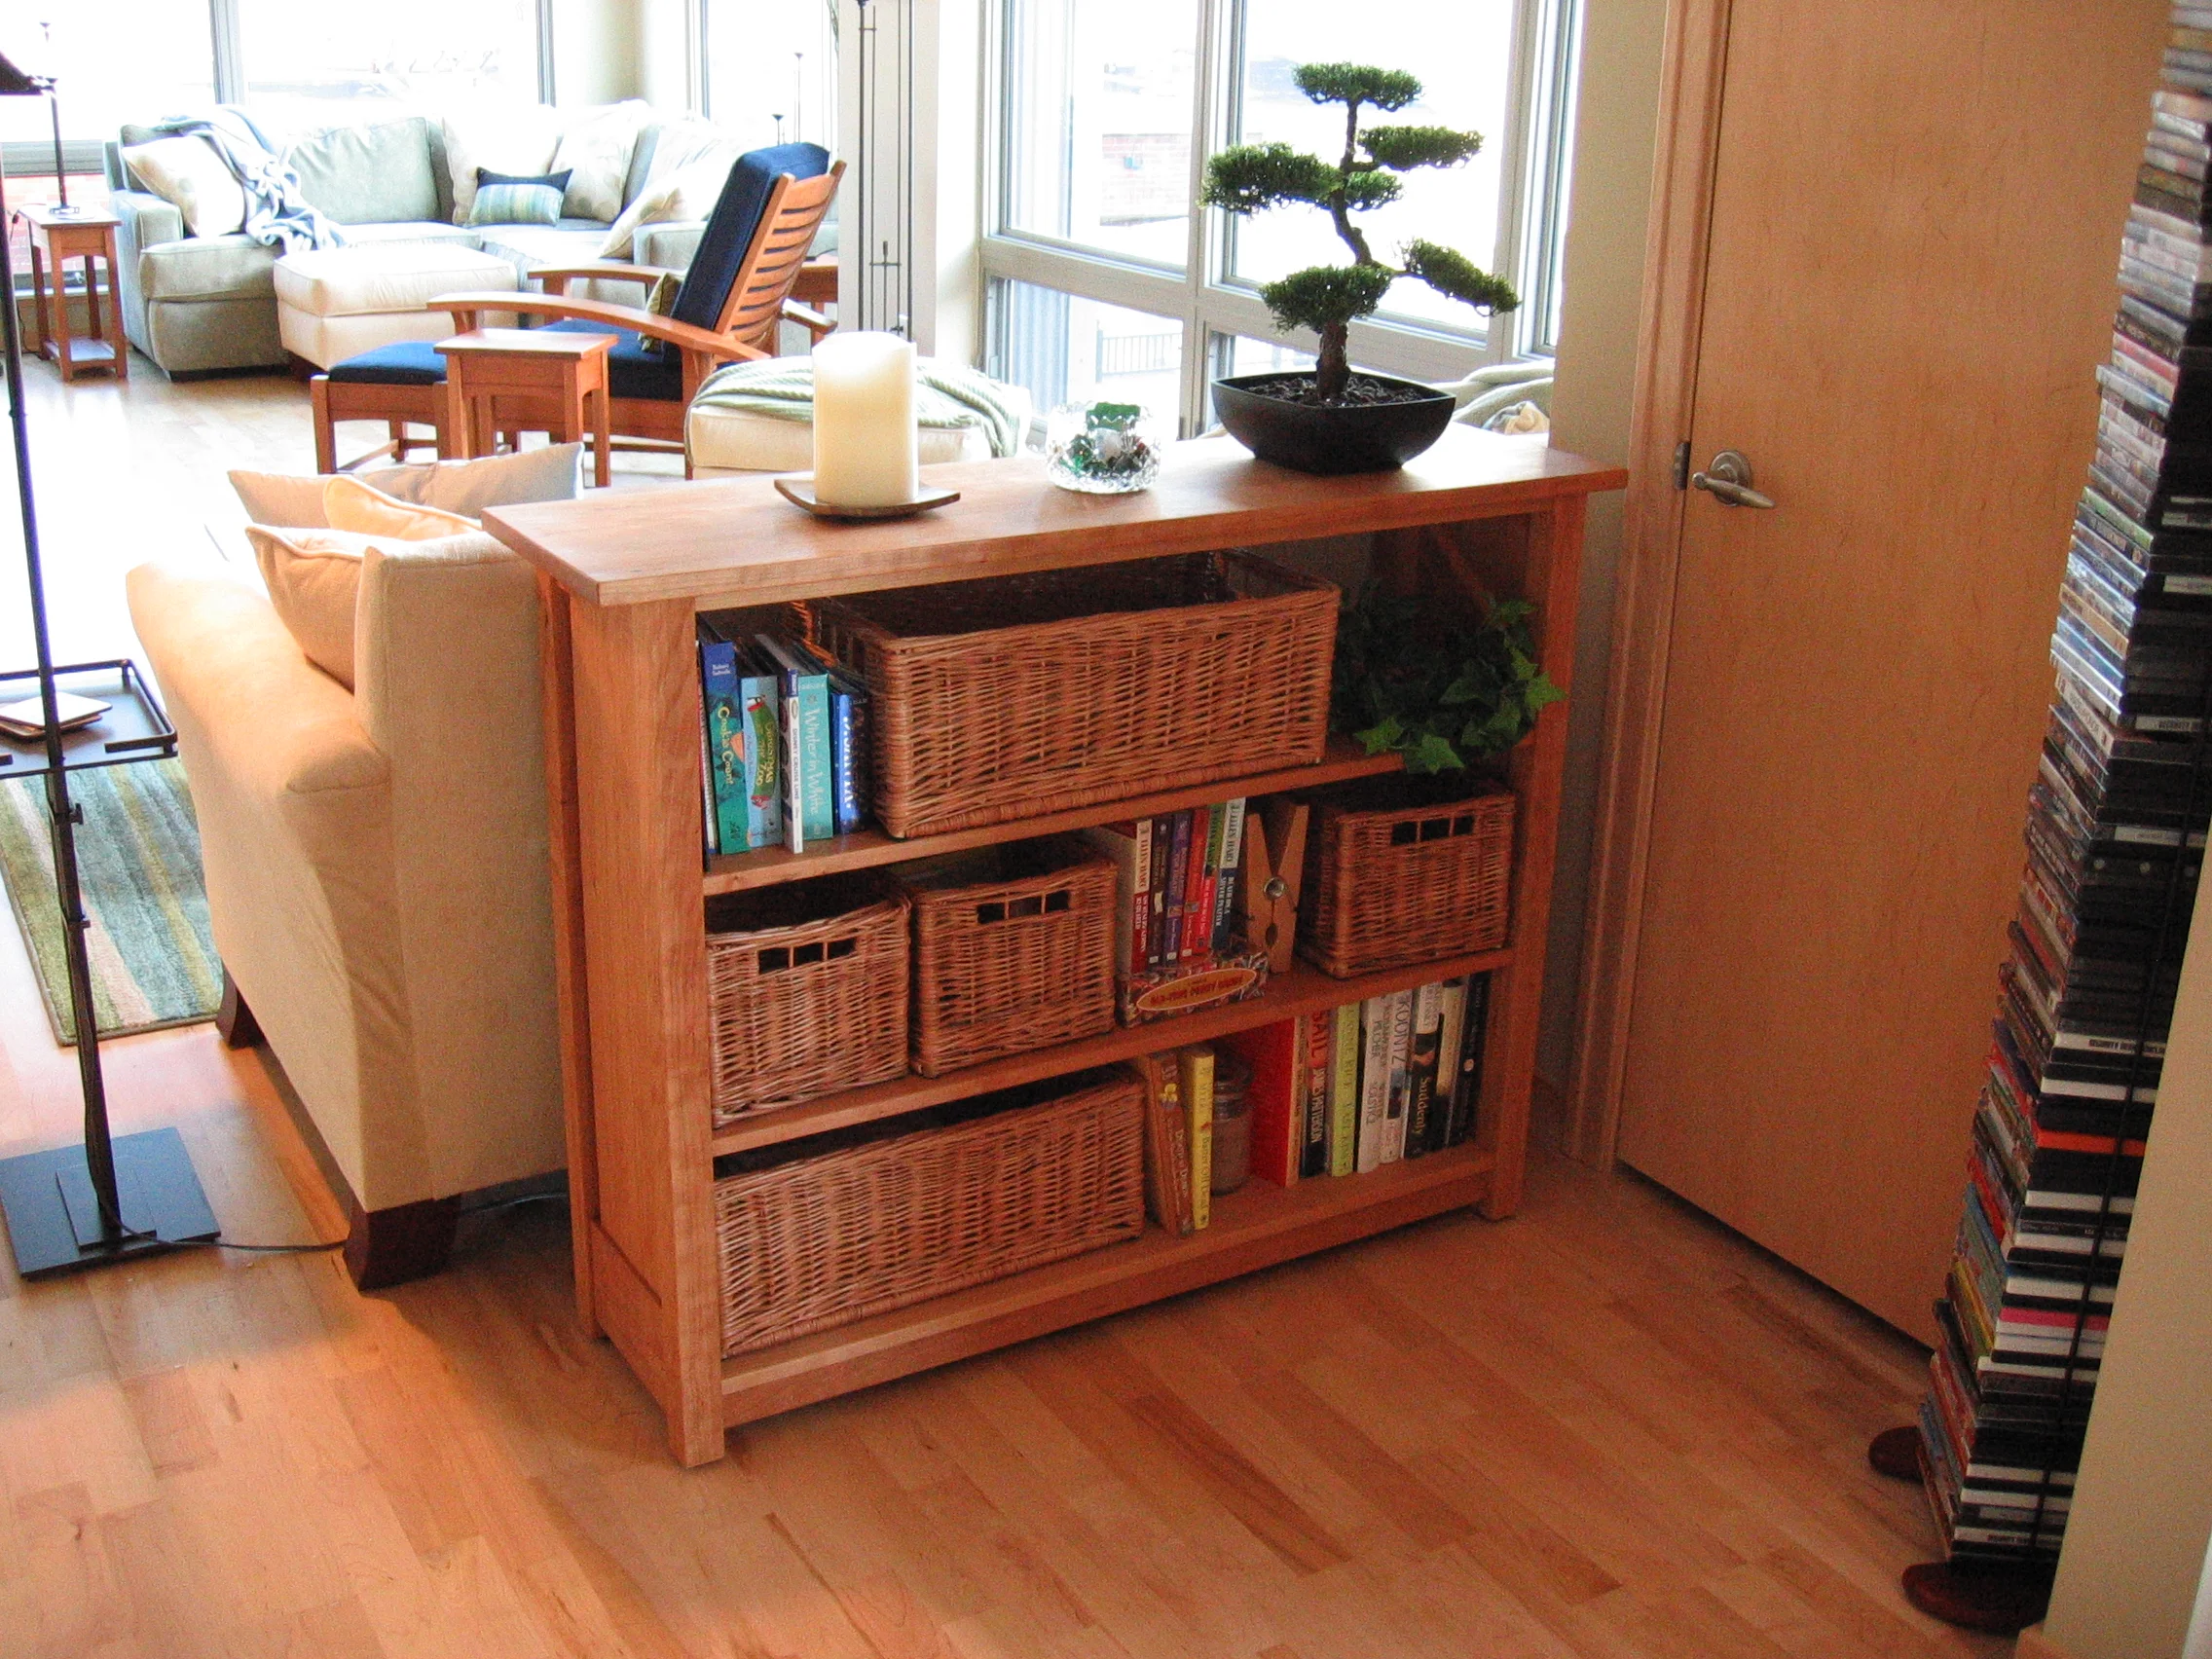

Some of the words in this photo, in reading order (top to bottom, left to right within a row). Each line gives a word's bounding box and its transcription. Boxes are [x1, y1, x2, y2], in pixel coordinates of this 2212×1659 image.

[803, 708, 823, 757] Winter
[722, 751, 734, 785] Count
[807, 771, 824, 815] White
[1370, 1019, 1381, 1059] PILCHER
[1390, 999, 1412, 1066] KOONTZ
[1309, 1094, 1324, 1143] PATTERSON
[1415, 1077, 1430, 1135] Suddenly
